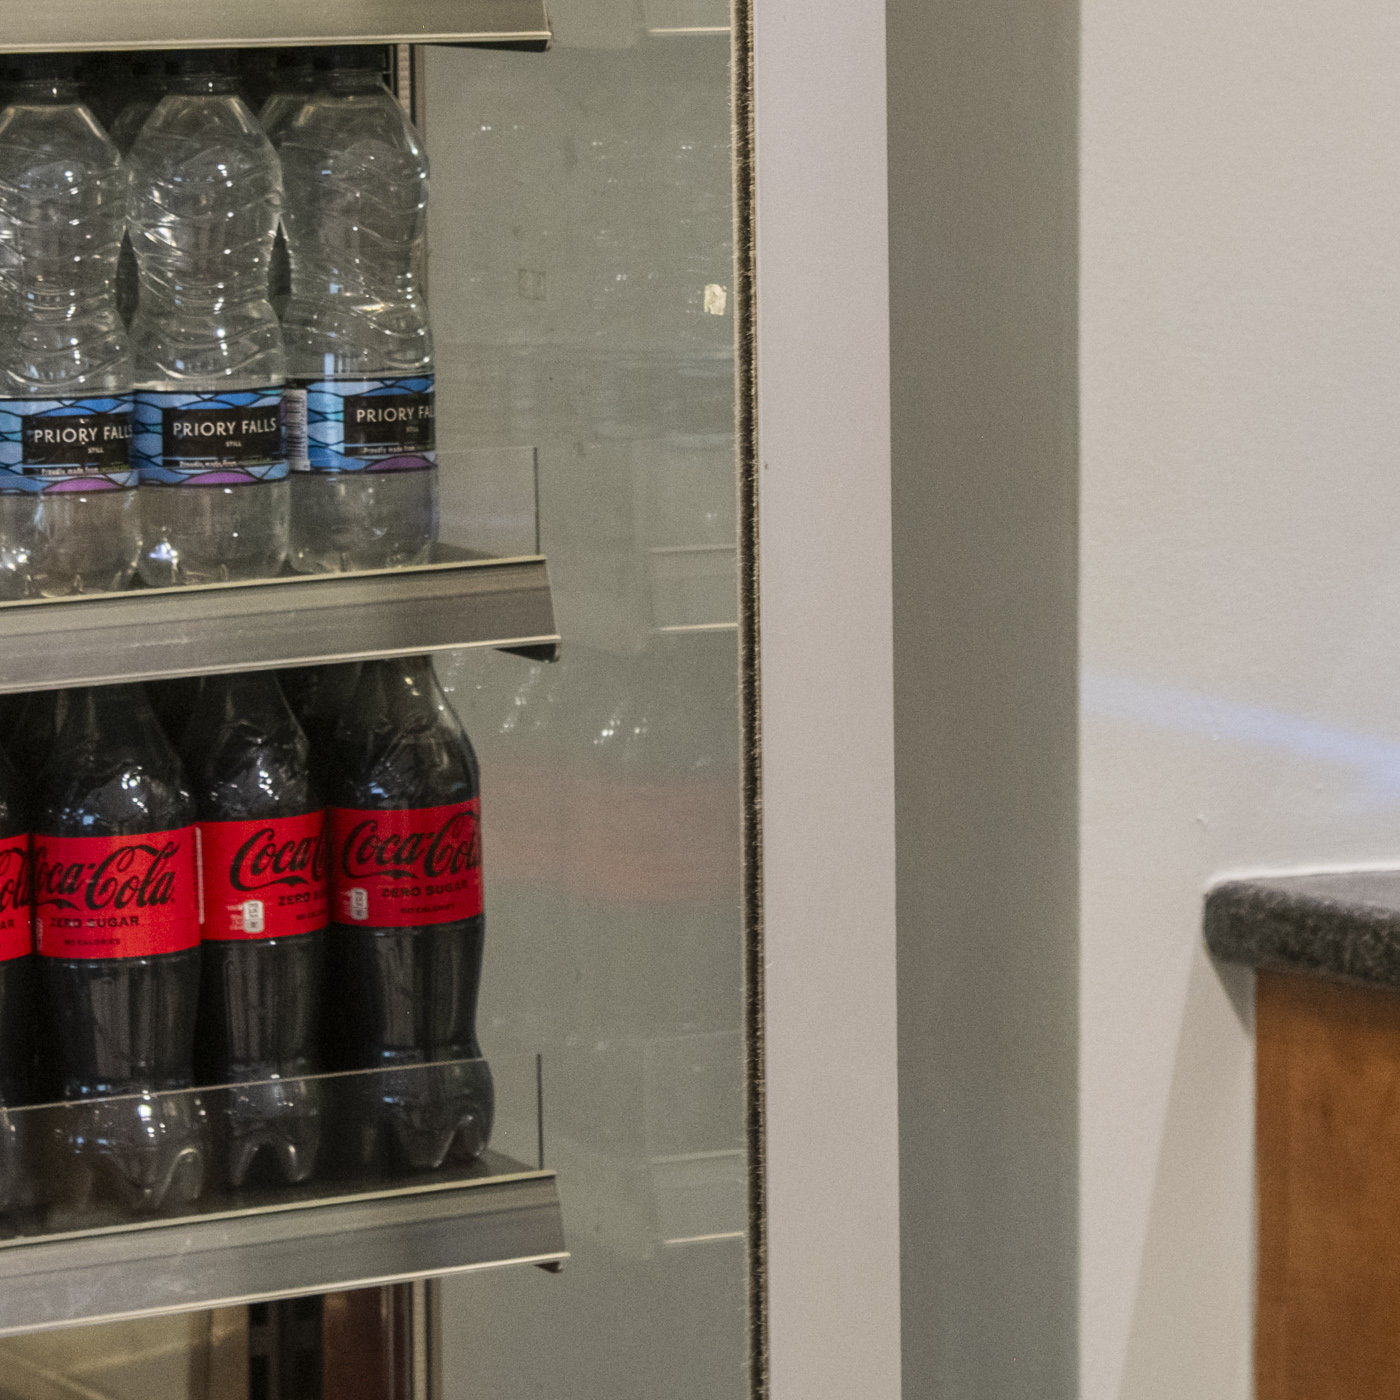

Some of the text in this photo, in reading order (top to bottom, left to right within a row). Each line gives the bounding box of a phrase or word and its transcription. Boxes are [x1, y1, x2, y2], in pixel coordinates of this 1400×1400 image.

[356, 406, 415, 423] PRIORY
[34, 427, 98, 443] PRIORY
[173, 418, 277, 437] PRIORY FALLS
[33, 841, 182, 912] oca-Cola
[382, 880, 469, 898] ZERO SUGAR
[278, 892, 311, 906] ZERO
[95, 915, 140, 929] SUGAR
[64, 937, 120, 946] NO CALORIES
